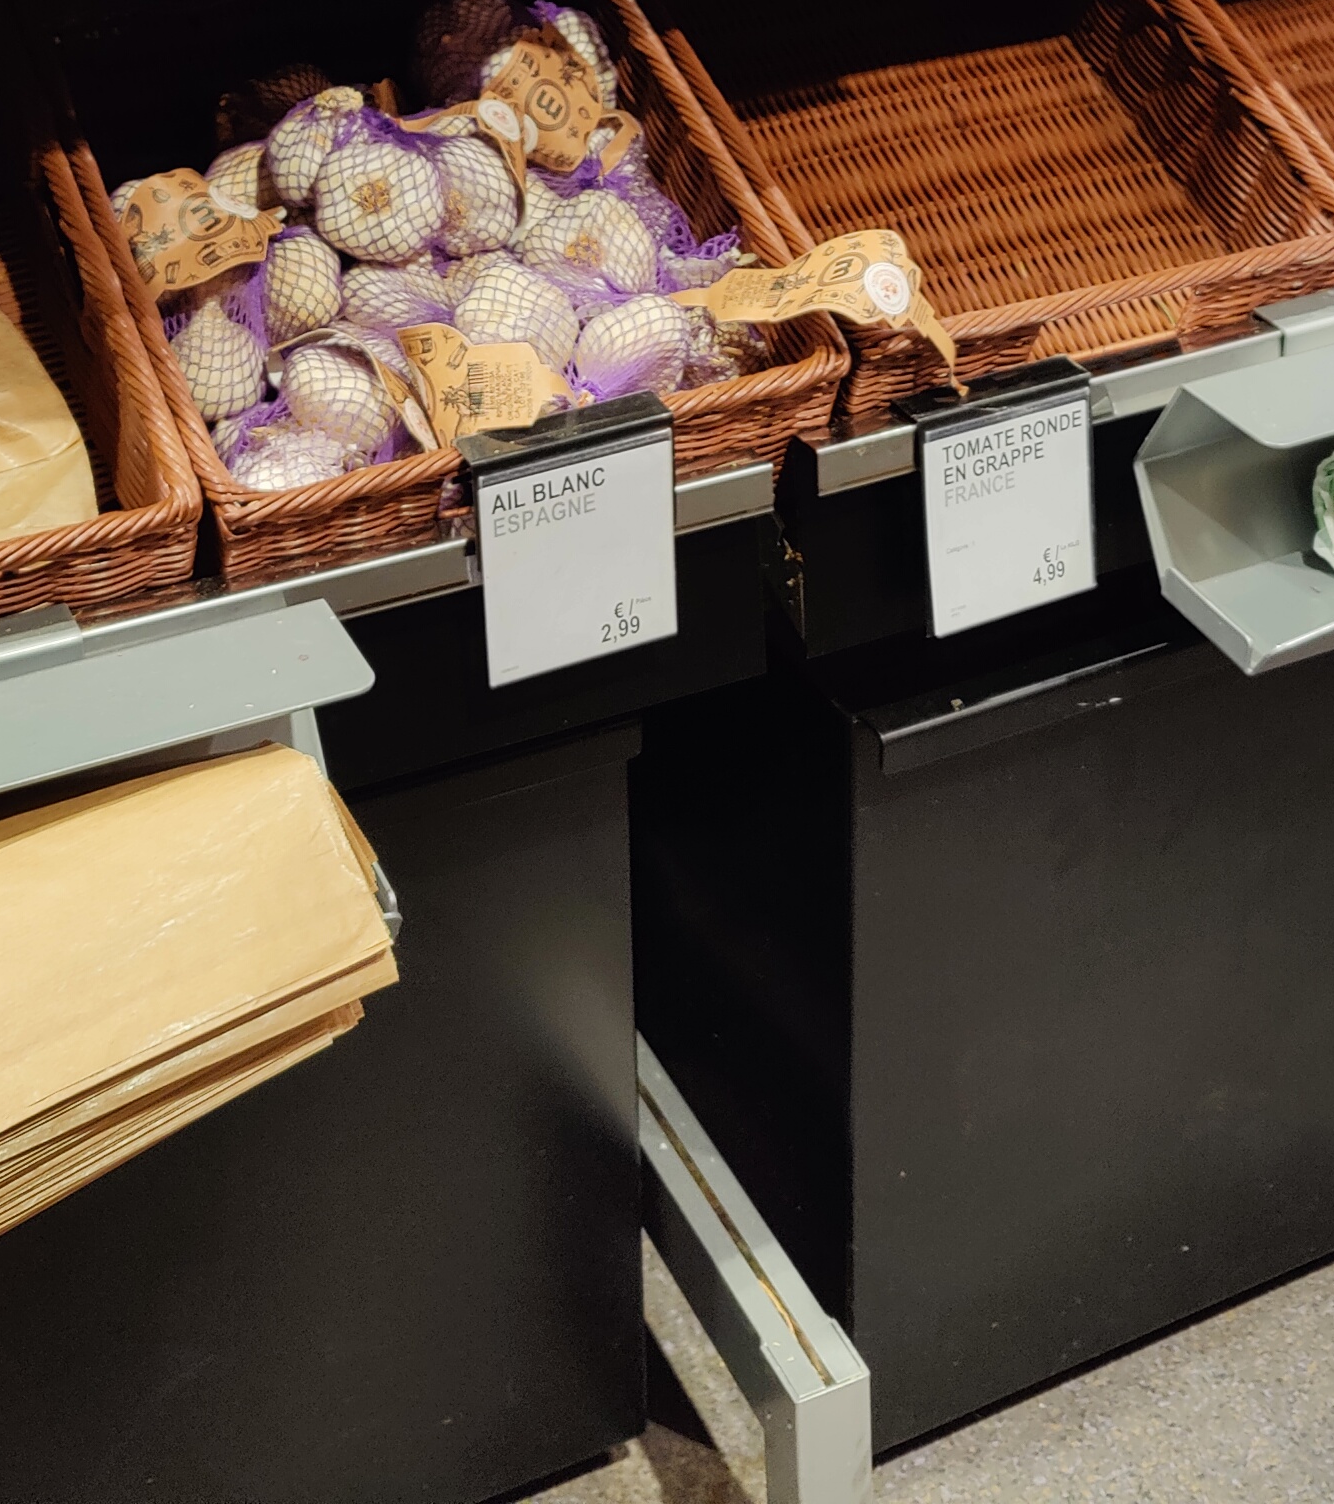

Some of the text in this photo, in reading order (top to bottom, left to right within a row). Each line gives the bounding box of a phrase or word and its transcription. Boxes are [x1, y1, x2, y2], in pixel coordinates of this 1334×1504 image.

[942, 409, 1083, 464] TOMATE RONDE
[944, 441, 1045, 486] EN GRAPPE
[492, 467, 606, 514] AIL BLANC
[945, 471, 1016, 508] FRANCE
[493, 493, 597, 538] ESPAGNE
[1033, 561, 1066, 586] 4,99
[601, 615, 640, 643] 2,99
